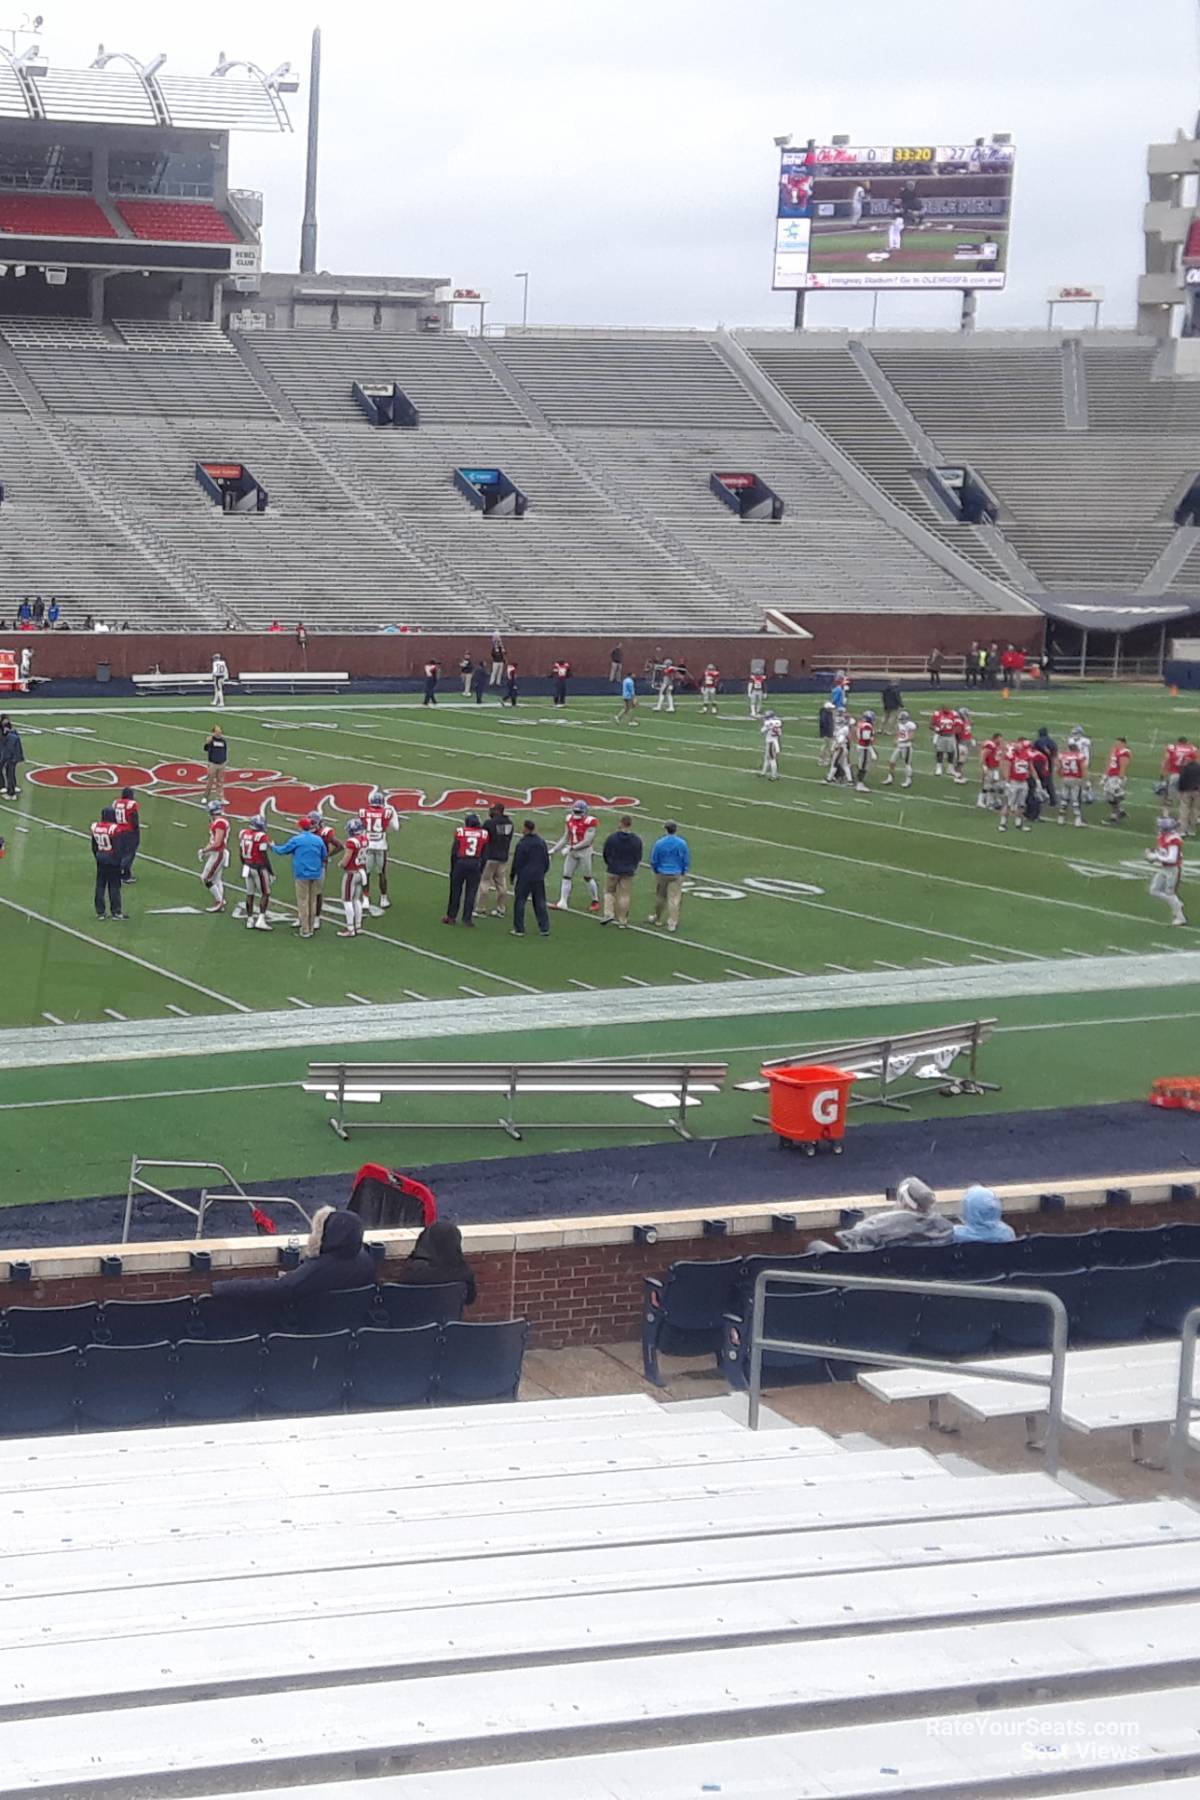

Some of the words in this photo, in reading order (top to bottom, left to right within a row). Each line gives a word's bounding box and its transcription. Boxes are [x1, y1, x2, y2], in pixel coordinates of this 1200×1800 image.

[894, 147, 932, 161] 33:20
[366, 818, 383, 833] 14
[241, 839, 254, 859] 17
[466, 837, 478, 857] 3
[811, 1088, 840, 1125] G
